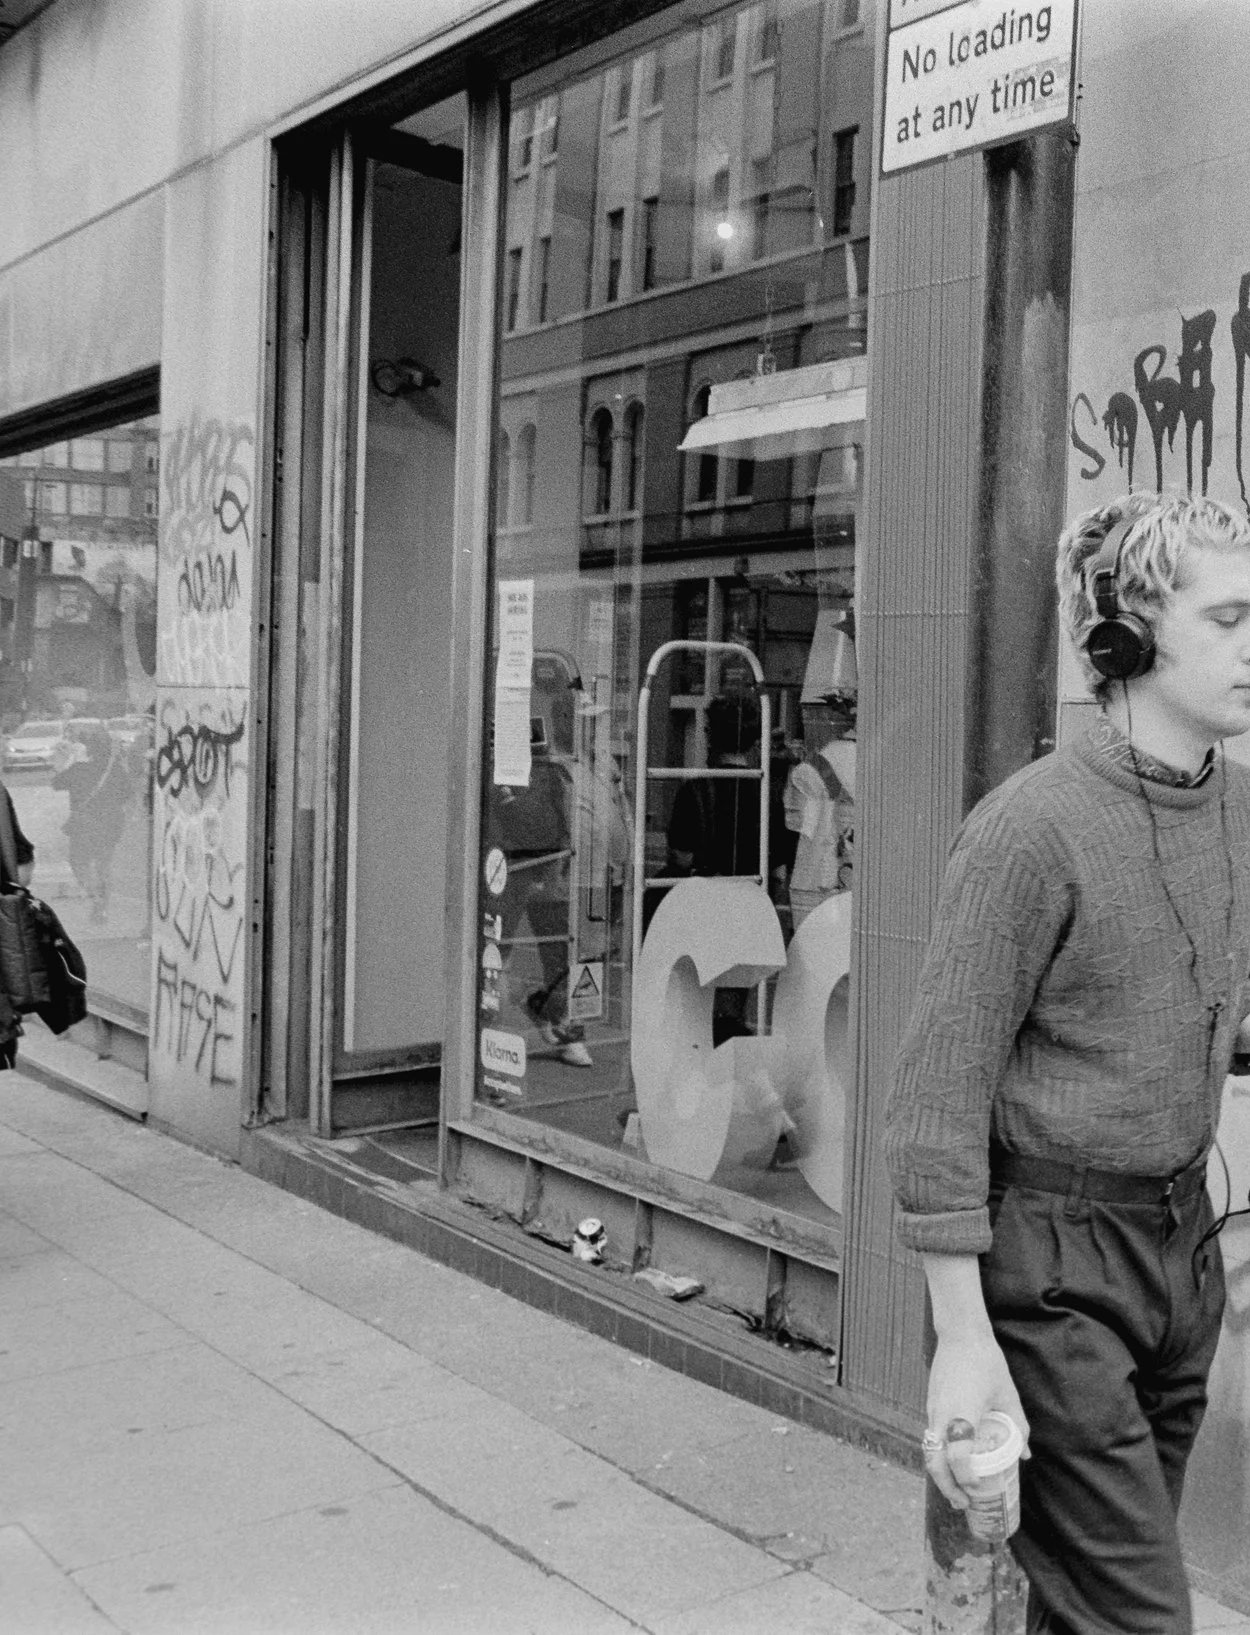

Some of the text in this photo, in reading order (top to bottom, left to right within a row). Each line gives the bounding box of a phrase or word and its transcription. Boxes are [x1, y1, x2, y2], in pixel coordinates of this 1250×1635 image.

[902, 6, 1052, 83] No loading
[897, 69, 1056, 144] at any time
